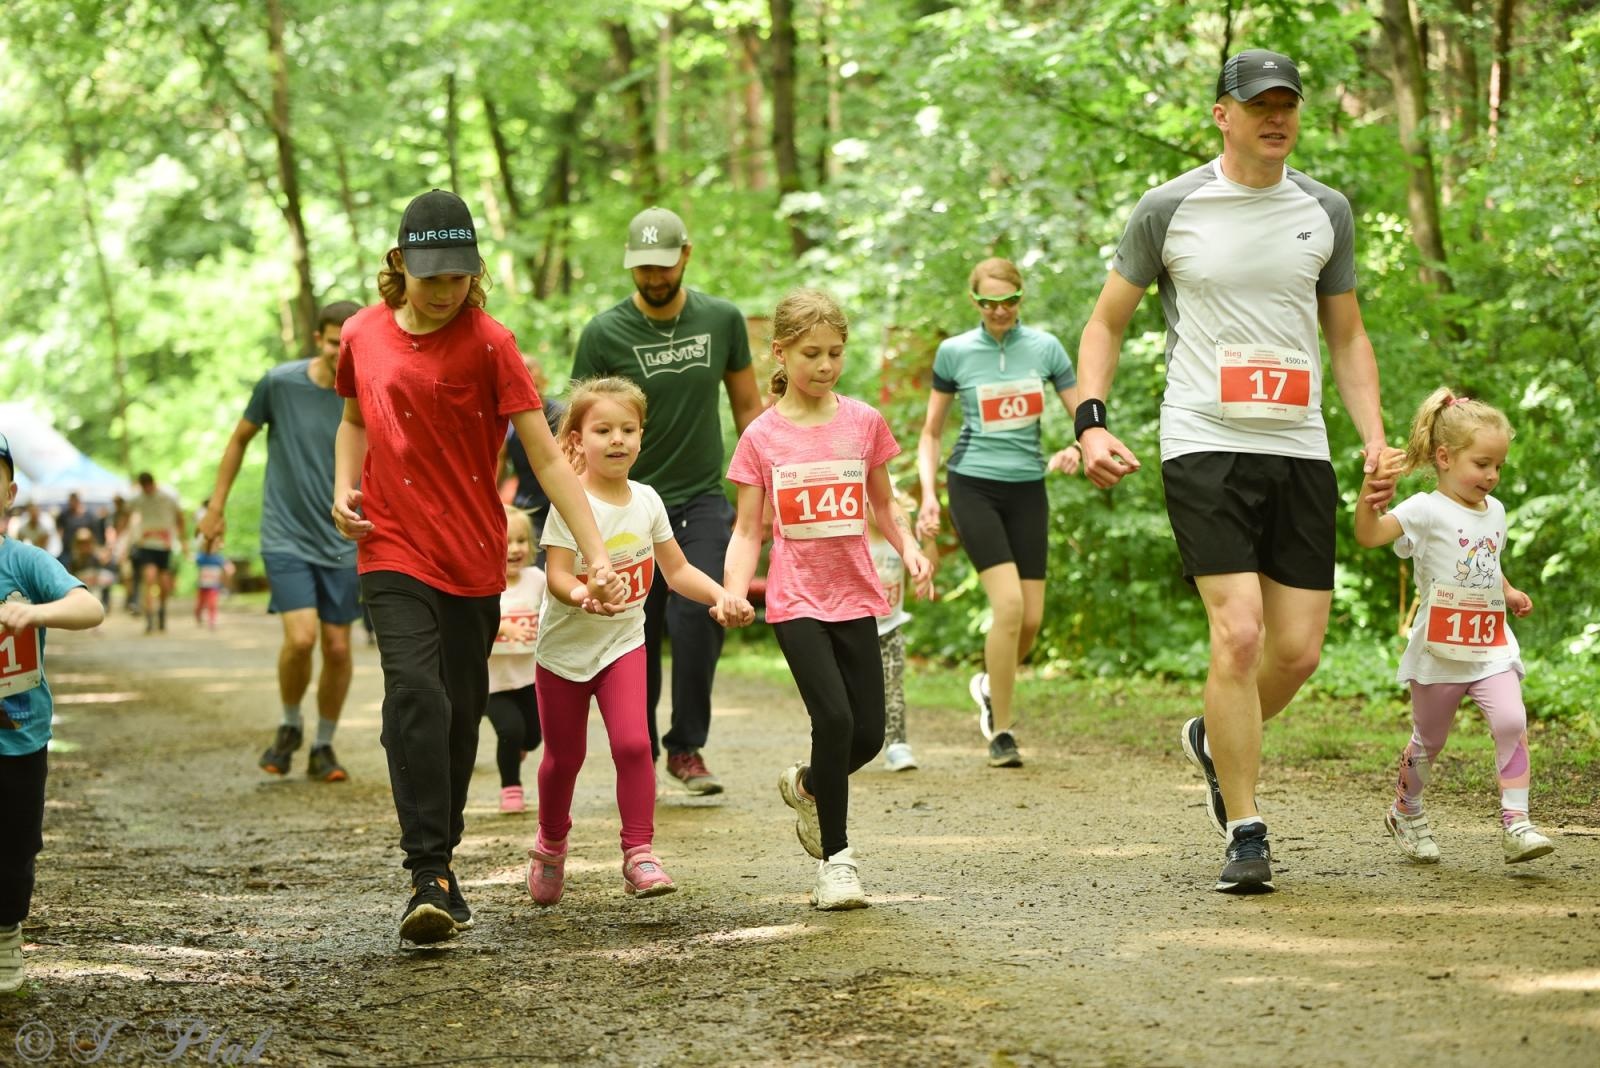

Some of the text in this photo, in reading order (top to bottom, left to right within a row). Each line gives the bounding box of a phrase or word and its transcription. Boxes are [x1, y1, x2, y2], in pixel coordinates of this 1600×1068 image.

[408, 229, 472, 242] BURGESS
[642, 226, 658, 244] NY
[1296, 231, 1312, 240] 4F
[1248, 369, 1288, 401] 17
[998, 395, 1028, 419] 60
[780, 471, 797, 479] Bieg
[794, 486, 858, 521] 146
[1436, 589, 1454, 599] Bieg
[1446, 612, 1496, 644] 113
